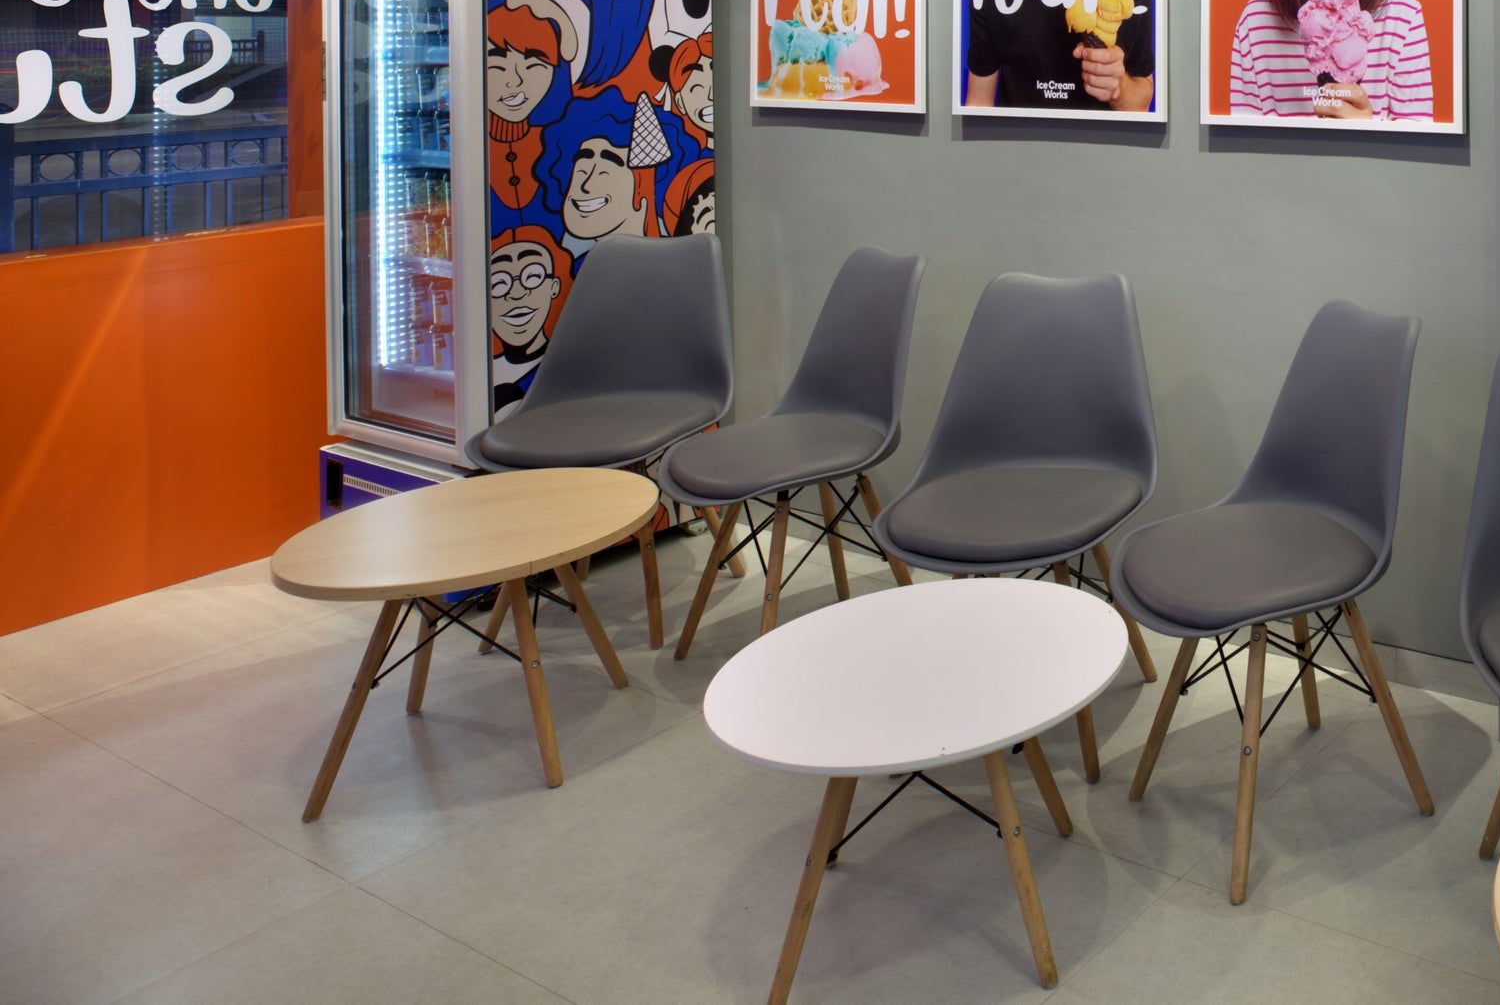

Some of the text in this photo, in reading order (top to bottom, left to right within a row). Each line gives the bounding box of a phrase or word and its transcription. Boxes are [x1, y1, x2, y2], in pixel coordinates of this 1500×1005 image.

[1036, 80, 1076, 91] Ice Cream
[1043, 90, 1069, 99] Works
[1303, 86, 1351, 97] Ice Cream
[1311, 96, 1342, 106] Works
